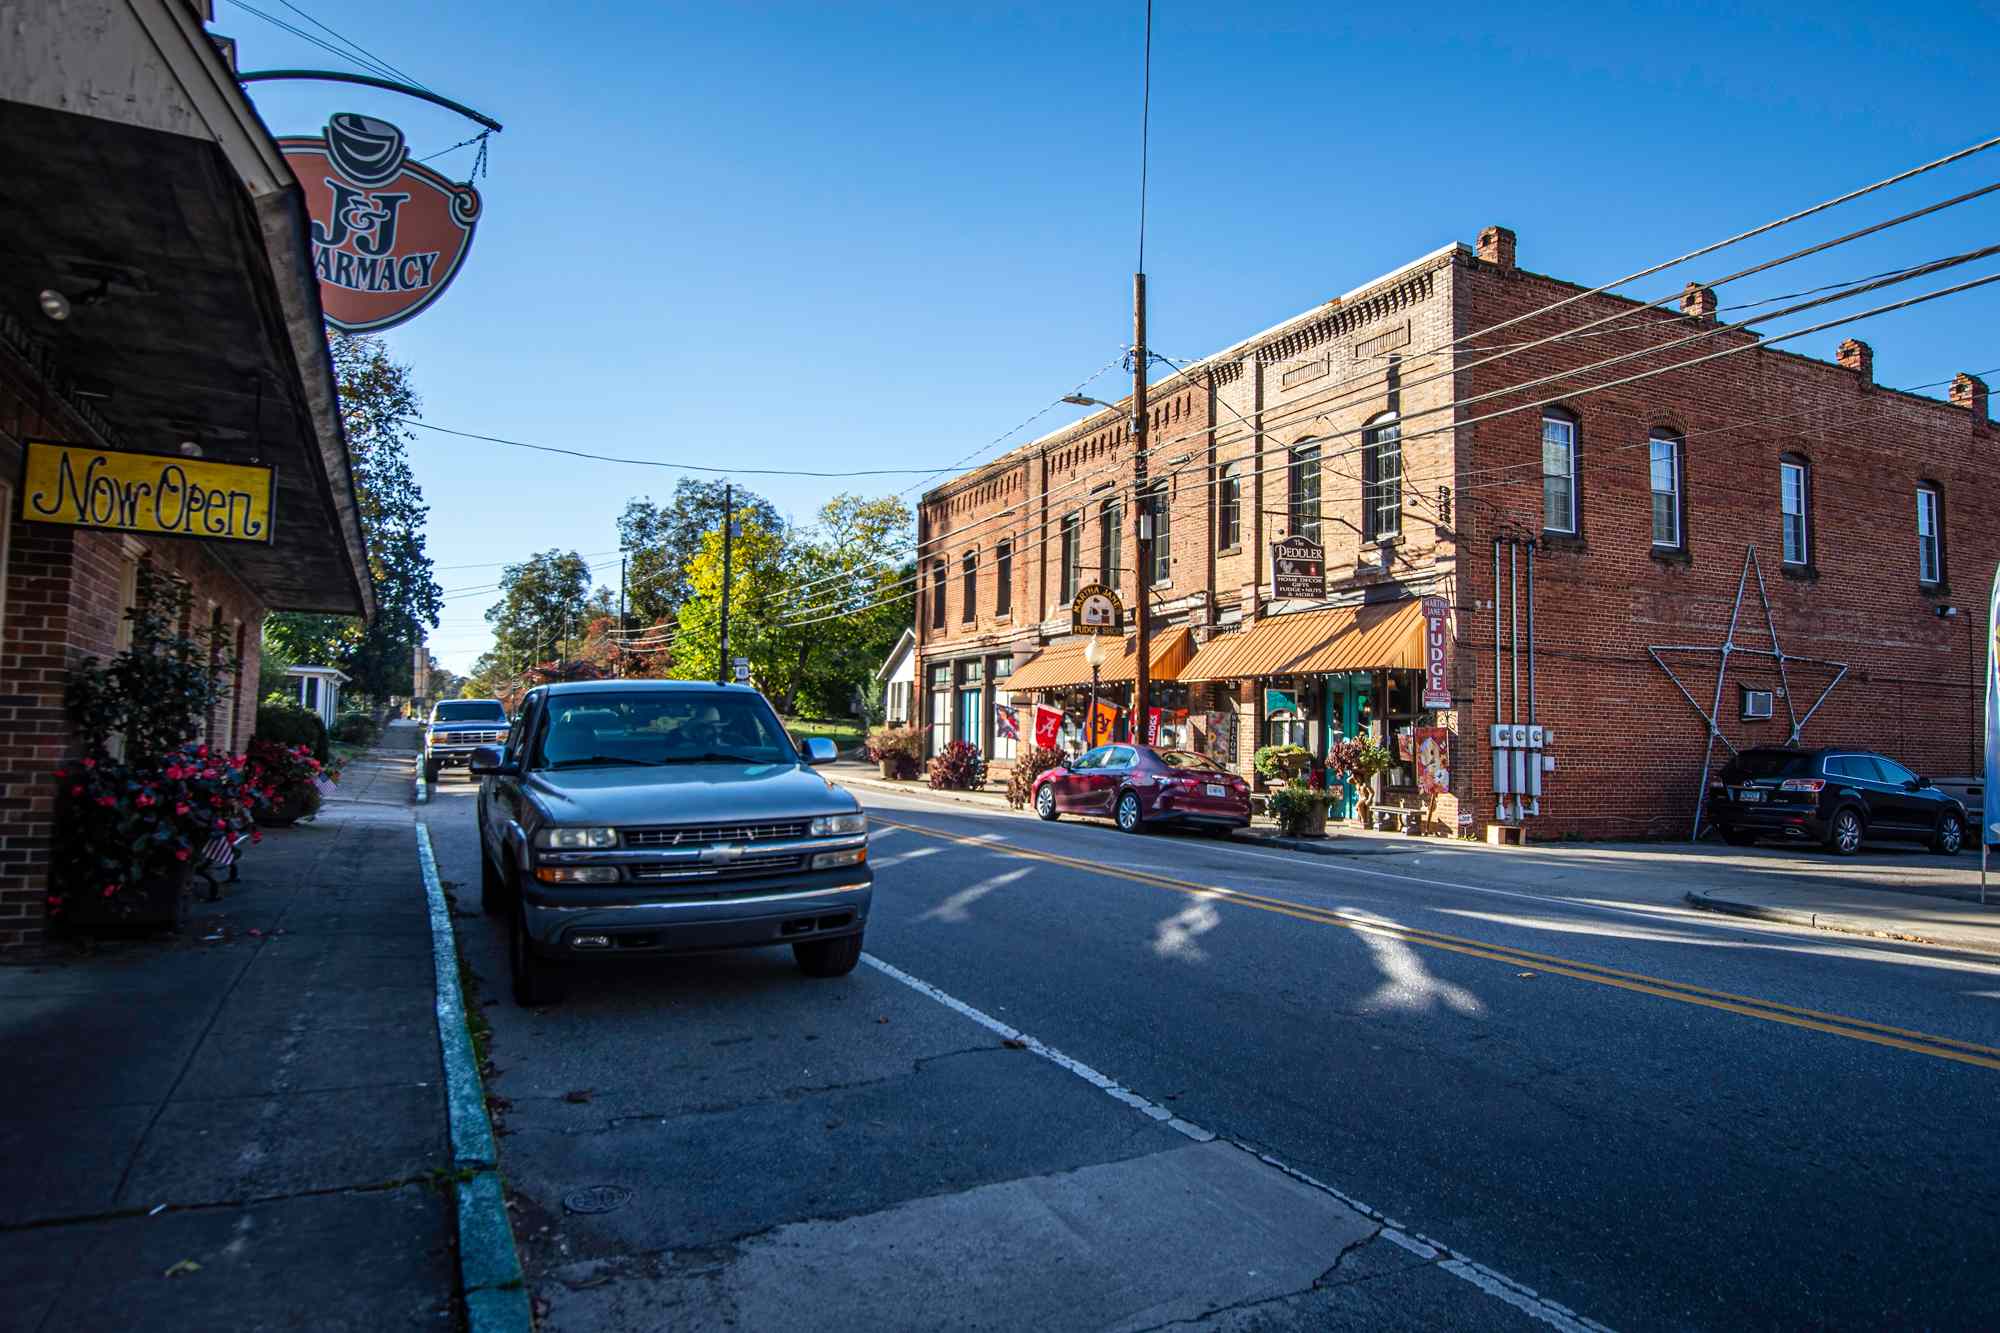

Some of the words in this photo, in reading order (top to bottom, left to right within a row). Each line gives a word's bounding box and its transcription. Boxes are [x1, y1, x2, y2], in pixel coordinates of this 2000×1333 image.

[312, 177, 411, 258] J&J
[312, 245, 441, 292] ARMACY
[32, 451, 152, 527] Now
[155, 464, 261, 536] Open
[1275, 545, 1323, 559] PEDDLER
[1074, 586, 1100, 614] MARTHA
[1430, 617, 1443, 690] FUDGE
[1148, 713, 1158, 746] LLDOGS
